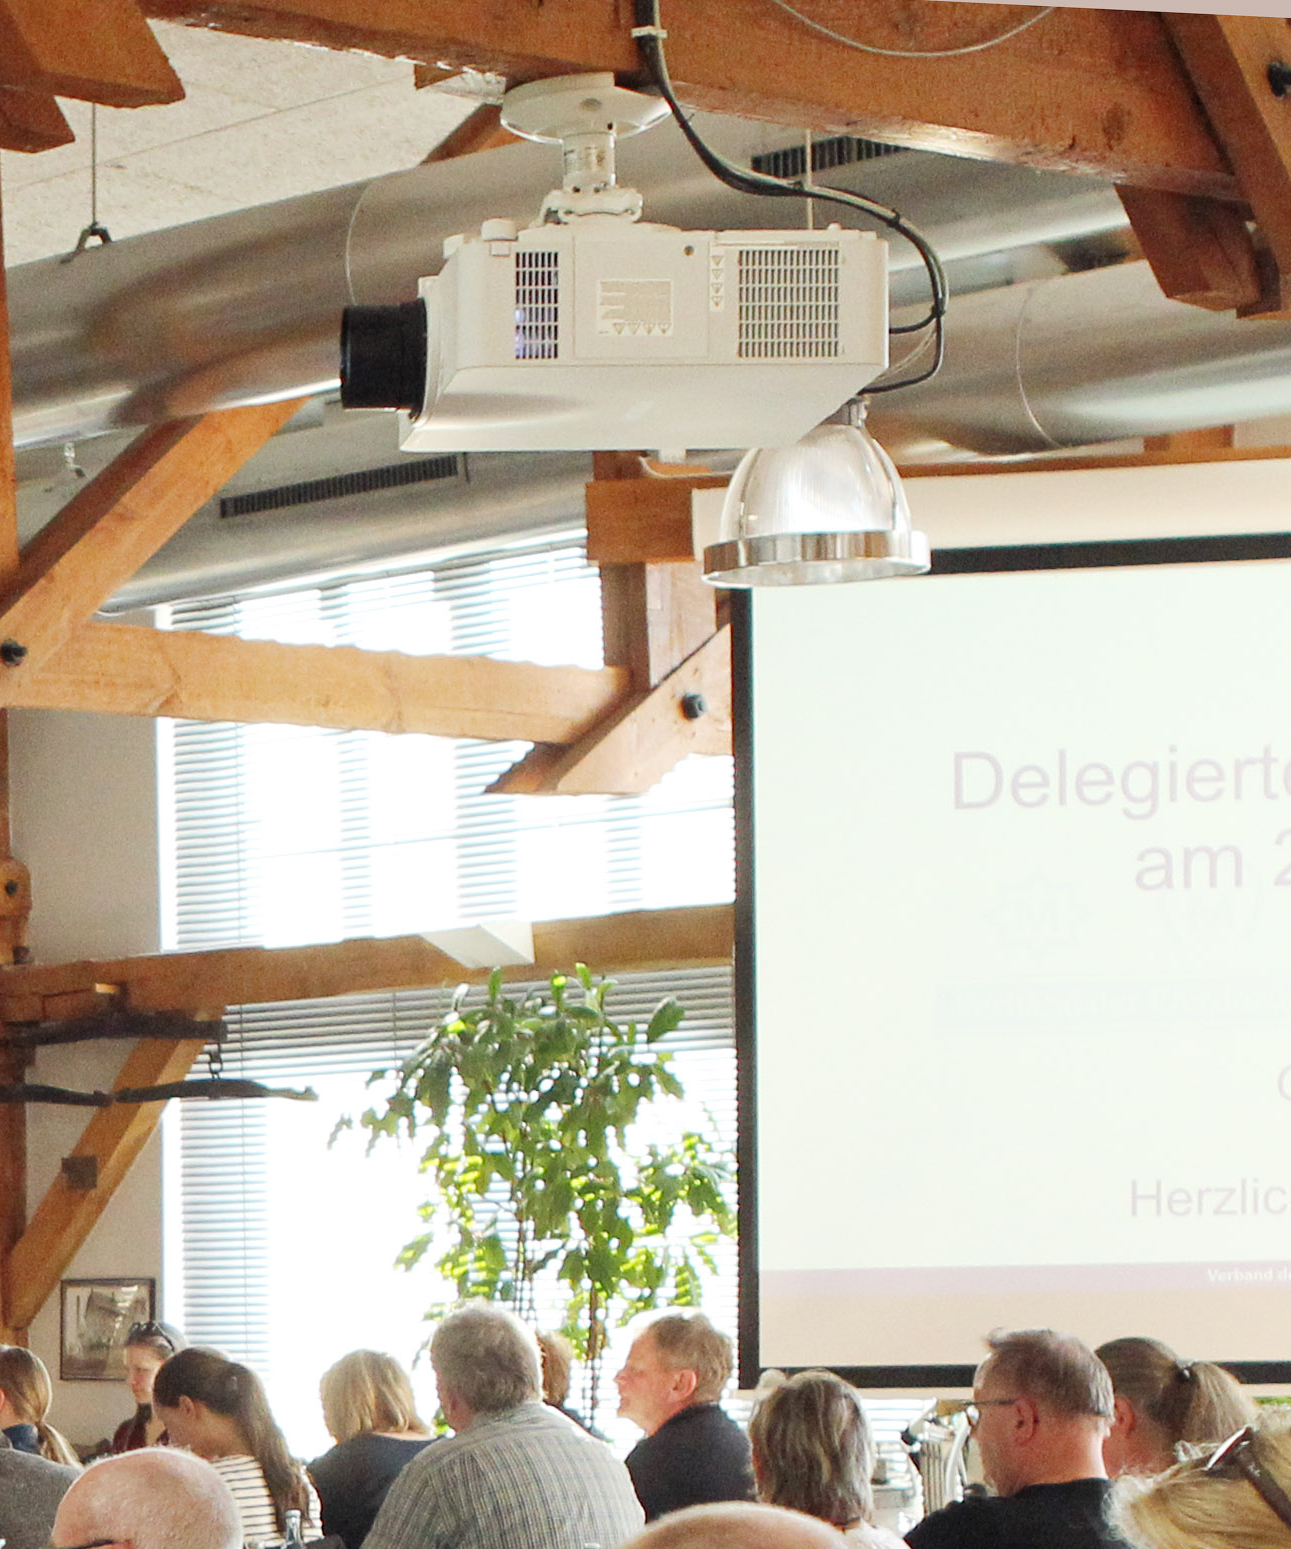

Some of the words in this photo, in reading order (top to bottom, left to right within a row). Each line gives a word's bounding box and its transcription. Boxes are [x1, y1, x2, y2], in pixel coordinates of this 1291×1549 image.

[952, 743, 1291, 821] Delegiert
[1134, 843, 1245, 891] am
[1206, 1267, 1273, 1283] Verband
